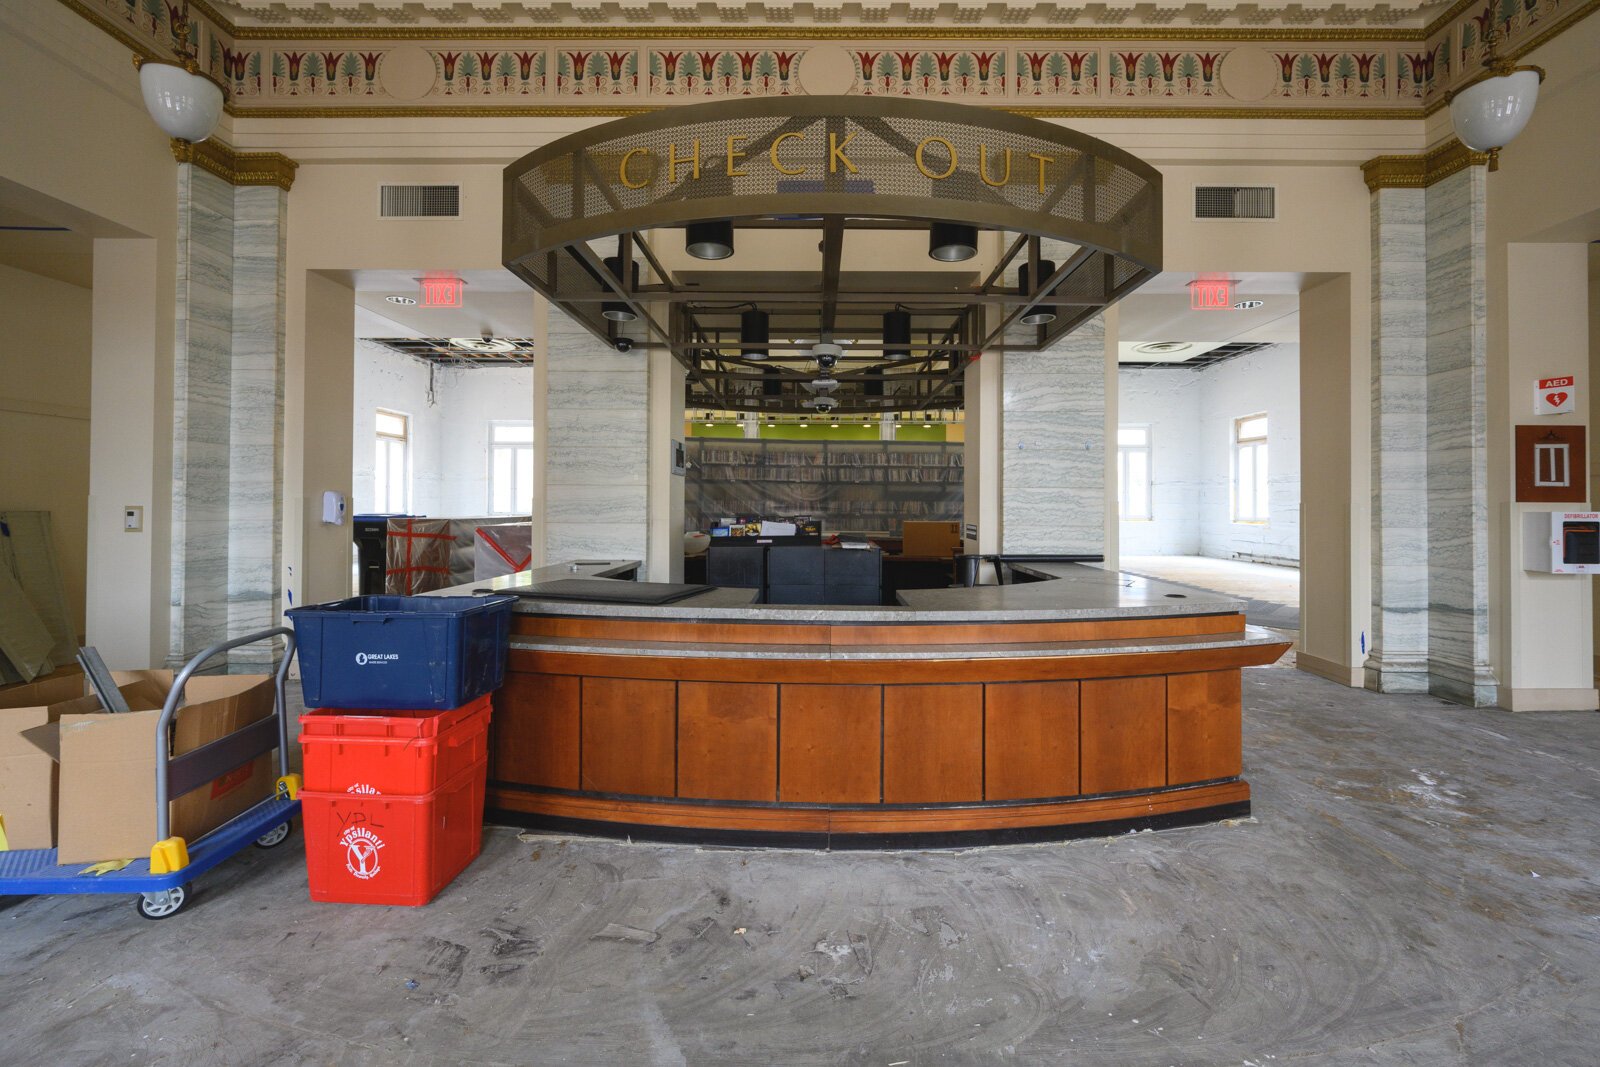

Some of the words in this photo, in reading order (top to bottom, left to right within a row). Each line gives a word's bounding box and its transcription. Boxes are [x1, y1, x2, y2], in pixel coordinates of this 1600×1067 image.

[618, 131, 860, 190] CHECK
[915, 137, 1056, 195] OUT
[1545, 378, 1568, 388] AED
[336, 812, 384, 837] YPL
[340, 828, 386, 850] Ypsilanti
